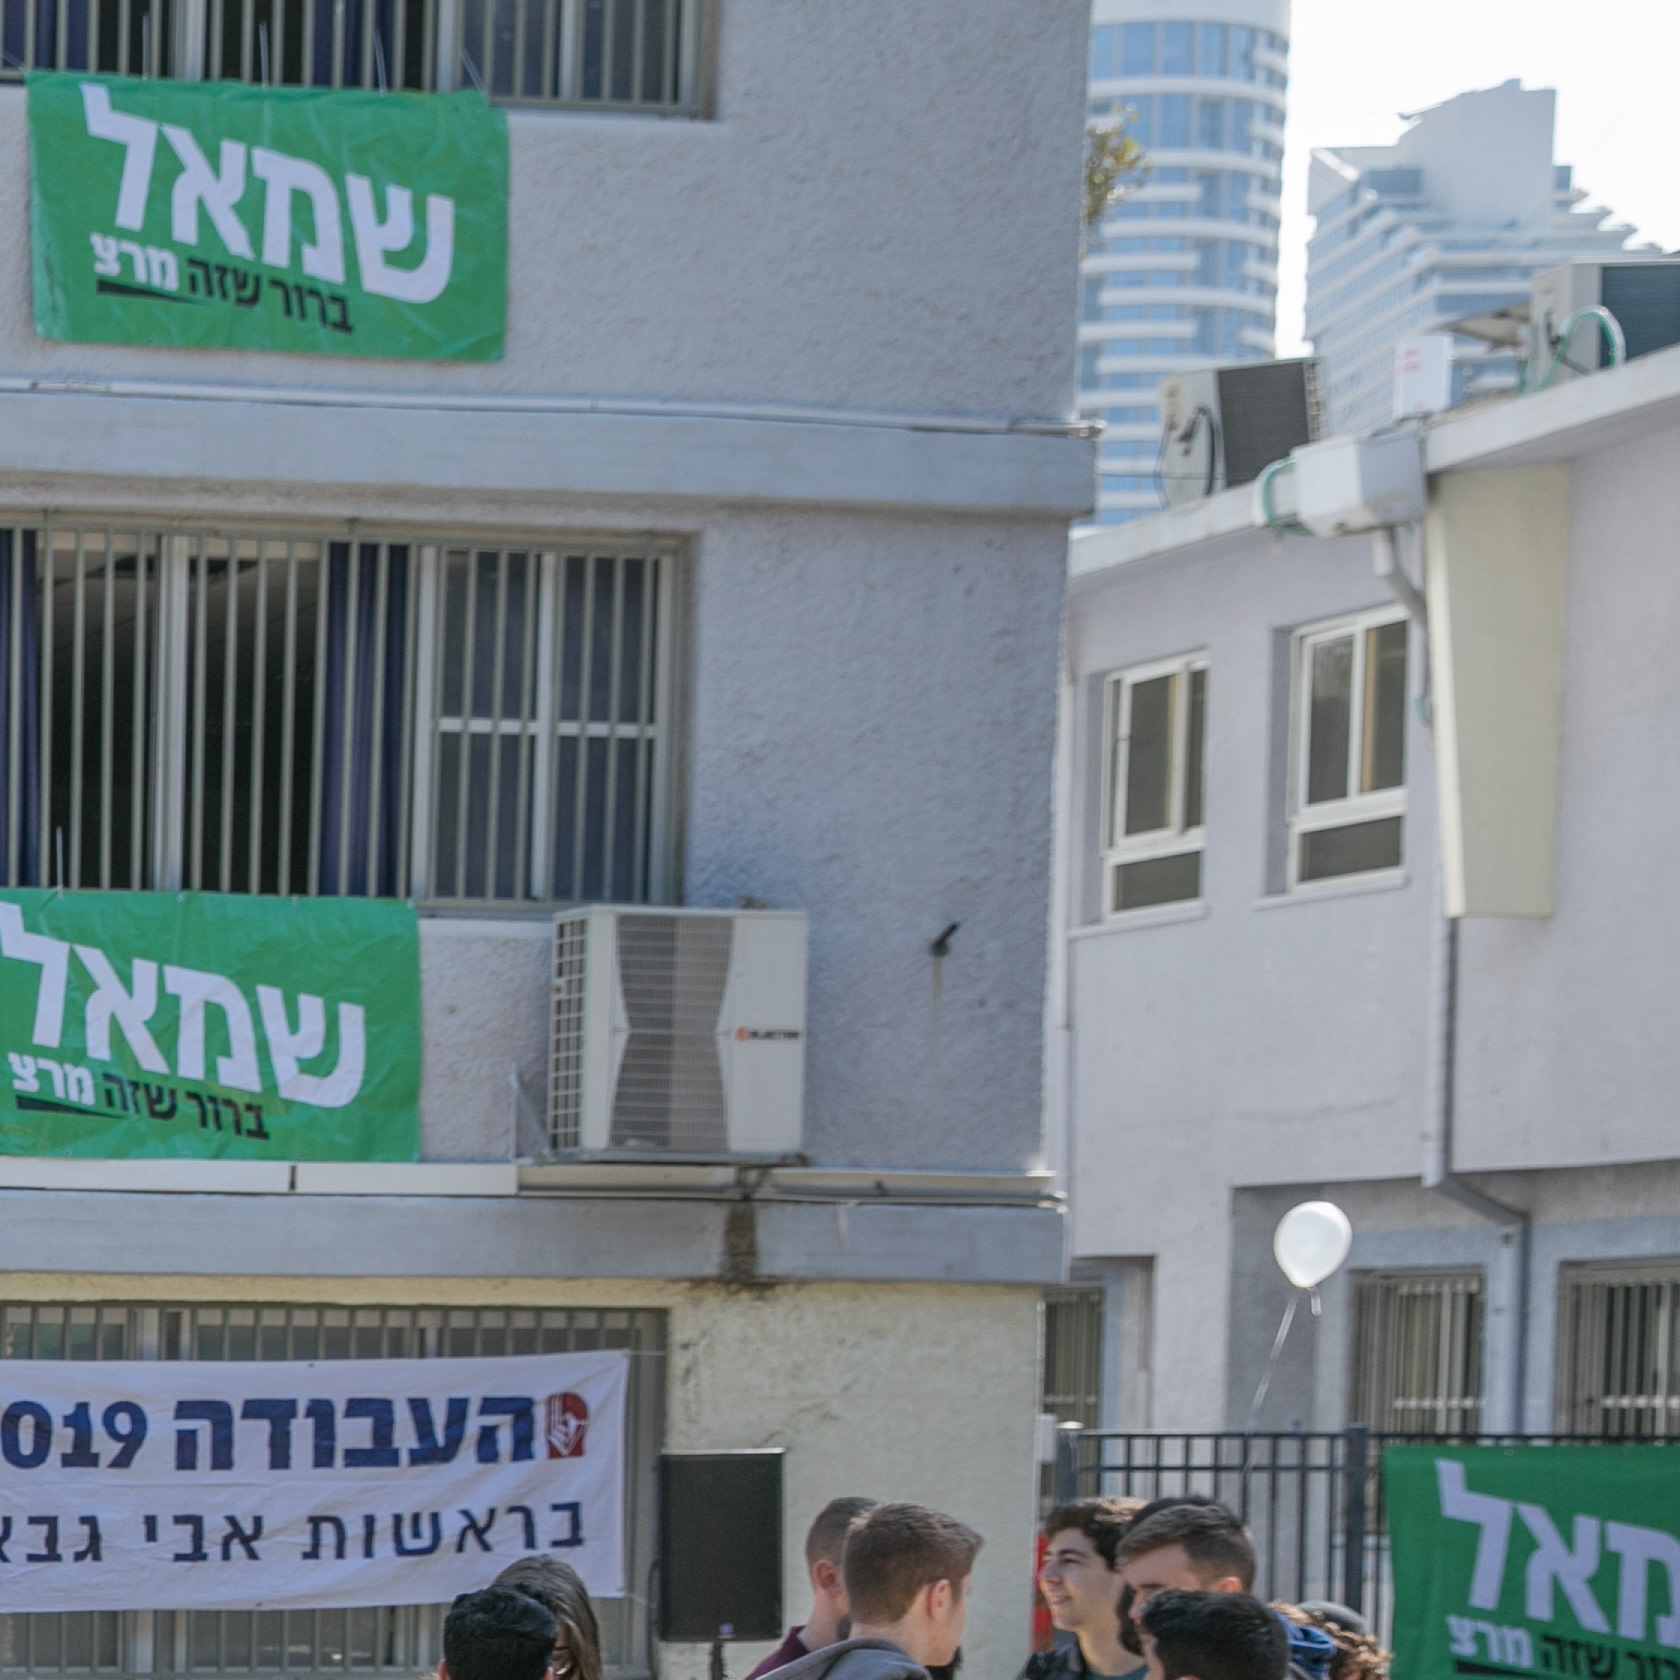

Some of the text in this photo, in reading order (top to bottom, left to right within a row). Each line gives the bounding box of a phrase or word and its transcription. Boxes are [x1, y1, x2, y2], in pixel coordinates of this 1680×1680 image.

[79, 82, 455, 304] שמאל
[90, 232, 354, 335] ברור שזה מרצ
[7, 1051, 270, 1140] ברור שזה מרצ
[173, 1395, 535, 1472] העבודה
[143, 1514, 264, 1563] אבי
[301, 1501, 585, 1560] בראשות
[1435, 1458, 1680, 1650] מאל
[1541, 1634, 1618, 1680] שזה
